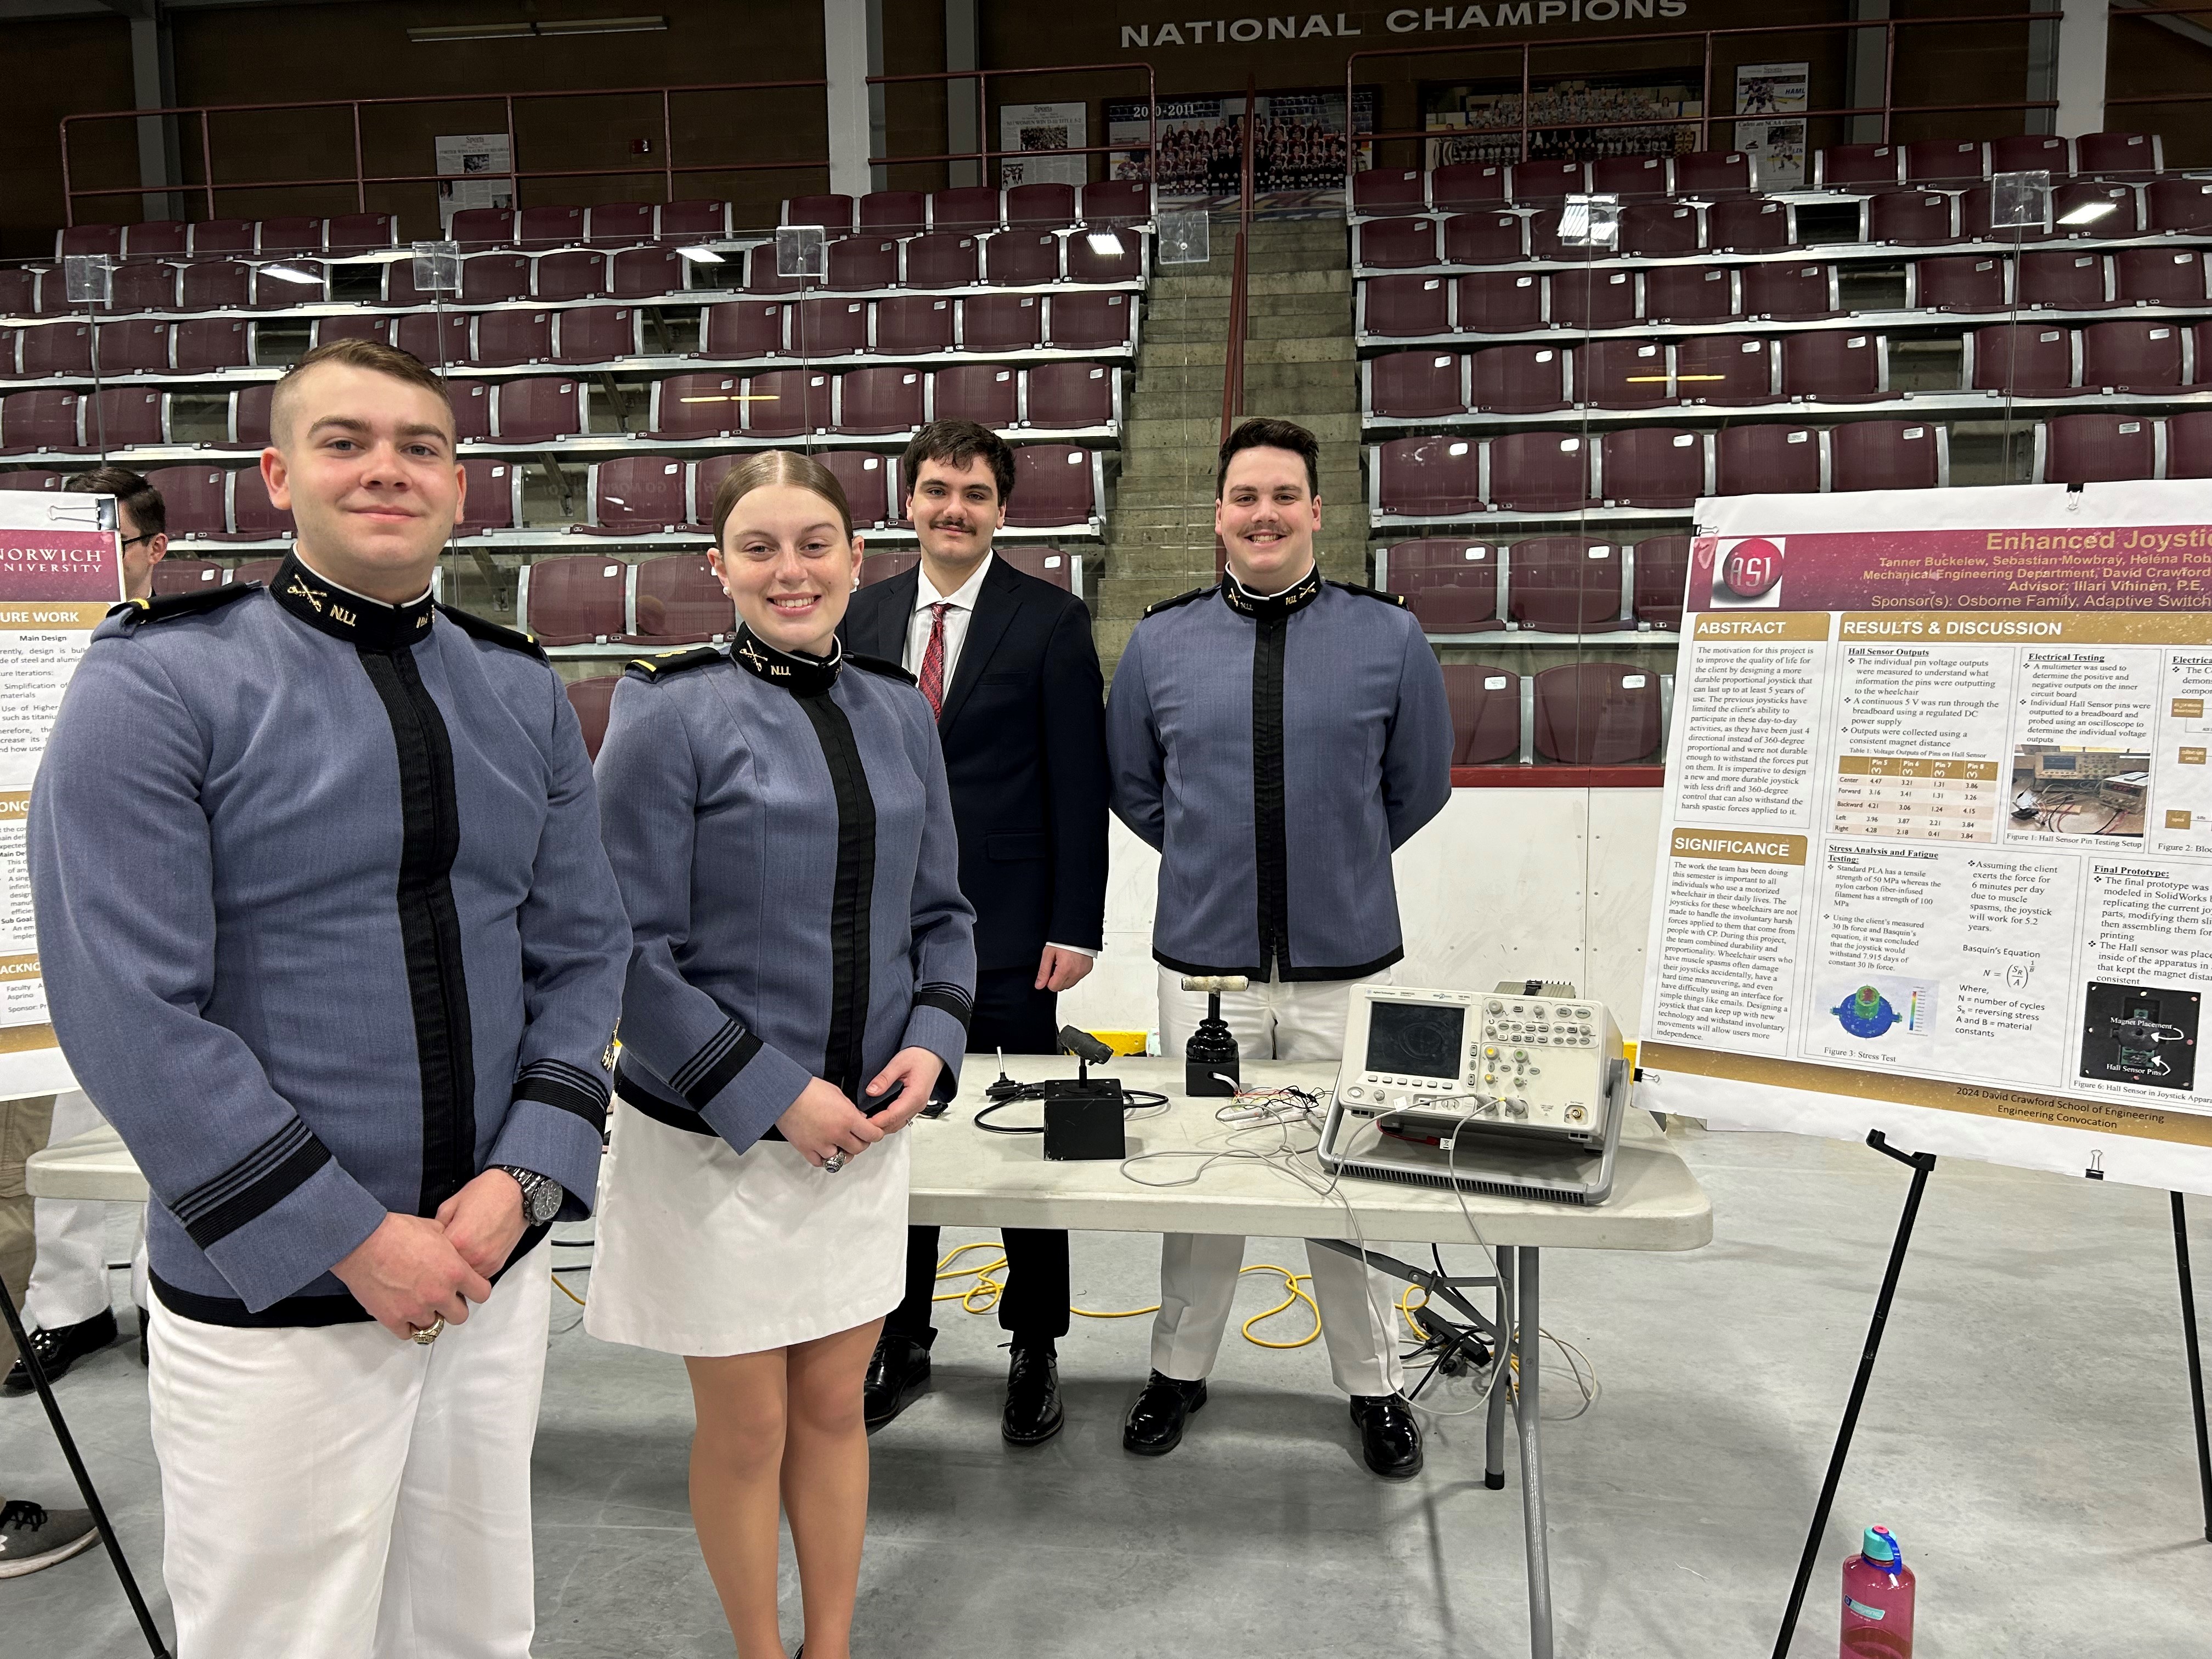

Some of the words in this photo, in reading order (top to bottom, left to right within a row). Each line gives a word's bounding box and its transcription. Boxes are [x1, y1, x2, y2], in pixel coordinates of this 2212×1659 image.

[1121, 13, 1362, 48] NATIONAL
[1386, 0, 1687, 33] CHAMPIONS
[1133, 104, 1194, 117] 200-2011
[1986, 531, 2115, 550] Enhanced
[1880, 557, 1921, 567] Tanner
[1925, 556, 1989, 567] Buckelew,
[1992, 555, 2058, 566] Sebastian
[2061, 554, 2125, 567] Mowbray,
[1863, 569, 1933, 580] Mechanical
[1937, 568, 2013, 581] Engineering
[2017, 568, 2098, 580] Department,
[2102, 567, 2142, 578] David
[2146, 566, 2211, 578] Crawford
[2007, 580, 2069, 591] Advisor:
[2177, 579, 2204, 591] P.E.
[1871, 595, 1952, 609] Sponsor(s):
[1957, 595, 2021, 607] Osborne
[2026, 594, 2079, 609] Family,
[2084, 594, 2153, 608] Adaptive
[32, 612, 80, 622] WORK
[1697, 622, 1786, 634] ABSTRACT
[1843, 619, 1923, 636] RESULTS
[1928, 621, 1941, 635] &
[1946, 619, 2062, 637] DISCUSSION
[1848, 648, 1865, 656] Hall
[1867, 648, 1894, 656] Sensor
[1896, 648, 1929, 657] Outputs
[2028, 652, 2070, 662] Electrical
[2072, 653, 2105, 663] Testing
[1748, 657, 1774, 665] quality
[1674, 837, 1790, 857] SIGNIFICANCE
[2006, 833, 2029, 841] Figure
[2094, 838, 2120, 848] Testing
[2121, 840, 2142, 849] Setup
[1829, 844, 1852, 853] Stress
[1854, 847, 1887, 855] Analysis
[1908, 850, 1939, 859] Fatigue
[1829, 854, 1859, 864] Testing:
[1768, 868, 1788, 878] doing
[2094, 865, 2118, 875] Final
[2120, 867, 2169, 878] Prototype:
[2003, 948, 2040, 958] Equation
[2110, 1017, 2136, 1025] Magnet
[2137, 1020, 2172, 1030] Placement
[1824, 1047, 1847, 1056] Figure
[1858, 1051, 1879, 1060] Stress
[1881, 1054, 1896, 1062] Test
[2123, 1065, 2146, 1074] Sensor
[2074, 1080, 2096, 1088] Figure
[2123, 1086, 2147, 1095] Sensor
[2157, 1091, 2186, 1100] Joystick
[1956, 1084, 1979, 1097] 2024
[1982, 1087, 2008, 1102] David
[2011, 1094, 2055, 1108] Crawford
[2057, 1100, 2090, 1113] School
[2092, 1105, 2104, 1114] of
[2106, 1107, 2165, 1124] Engineering
[1997, 1104, 2055, 1121] Engineering
[2056, 1113, 2117, 1128] Convocation
